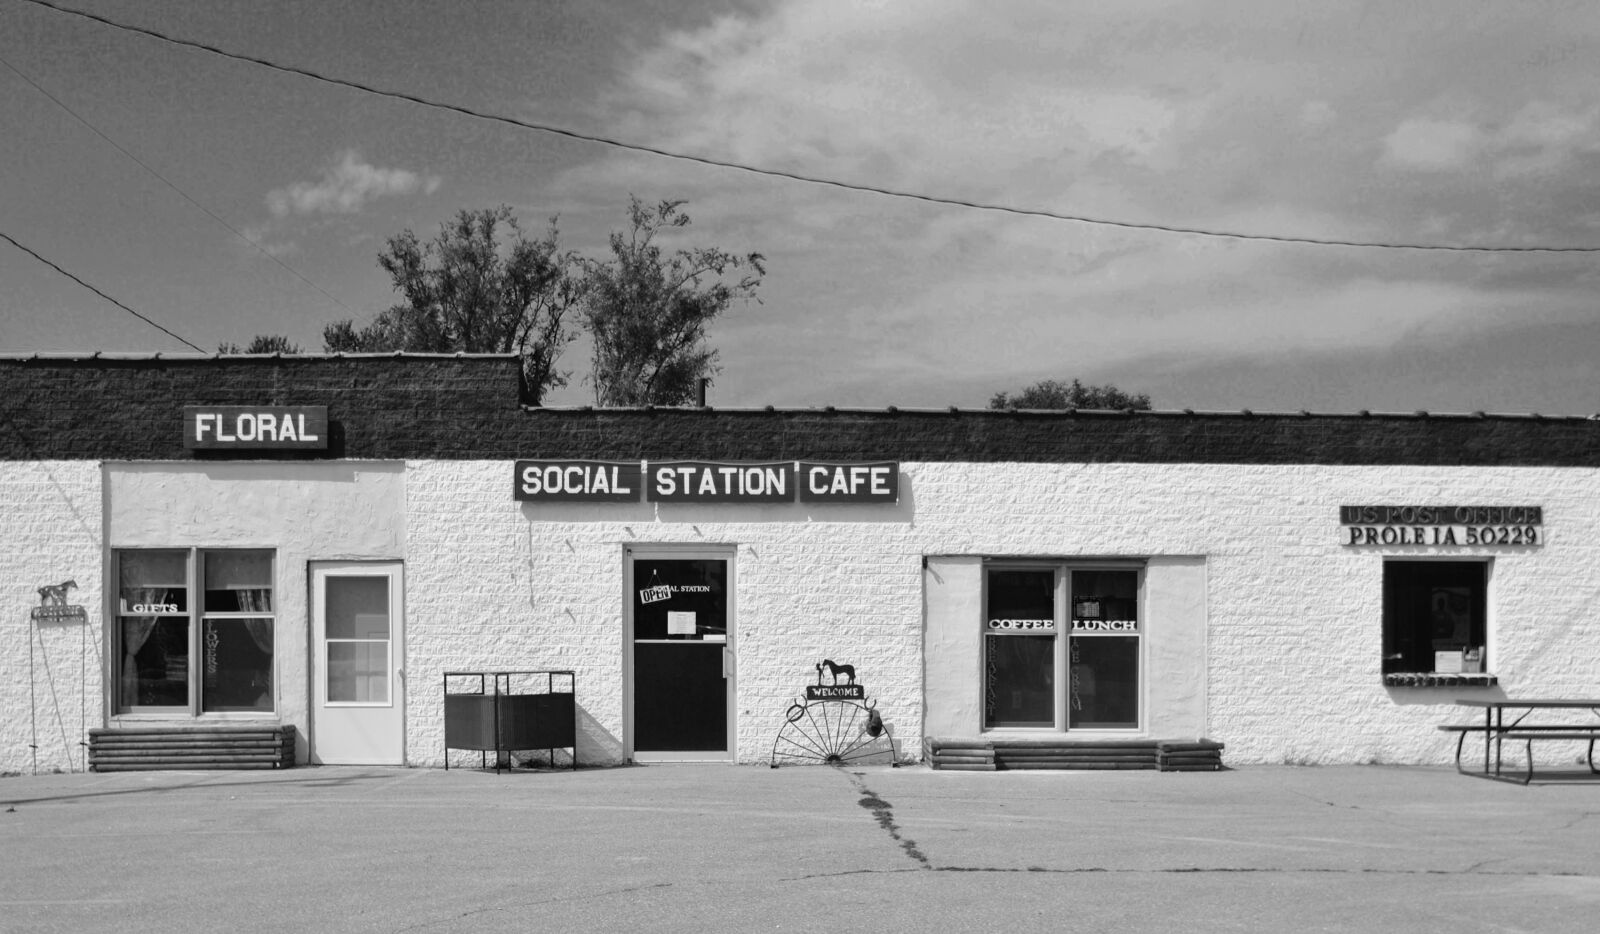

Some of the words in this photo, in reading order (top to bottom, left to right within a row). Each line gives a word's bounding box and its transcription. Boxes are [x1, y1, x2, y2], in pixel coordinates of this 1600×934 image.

[195, 413, 319, 442] FLORAL
[522, 466, 631, 494] SOCIAL
[656, 467, 785, 495] STATION
[808, 467, 891, 494] CAFE
[1345, 506, 1378, 523] US
[1386, 506, 1440, 523] POST
[1454, 506, 1538, 523] OFFICE
[1348, 527, 1424, 545] PROLE
[1433, 527, 1457, 545] IA
[1465, 527, 1536, 545] 50229
[642, 587, 669, 602] OPEN
[132, 604, 178, 613] GIFTS
[989, 619, 1054, 629] COFFEE
[1072, 621, 1137, 630] LUNCH
[813, 688, 858, 696] WELCOME
